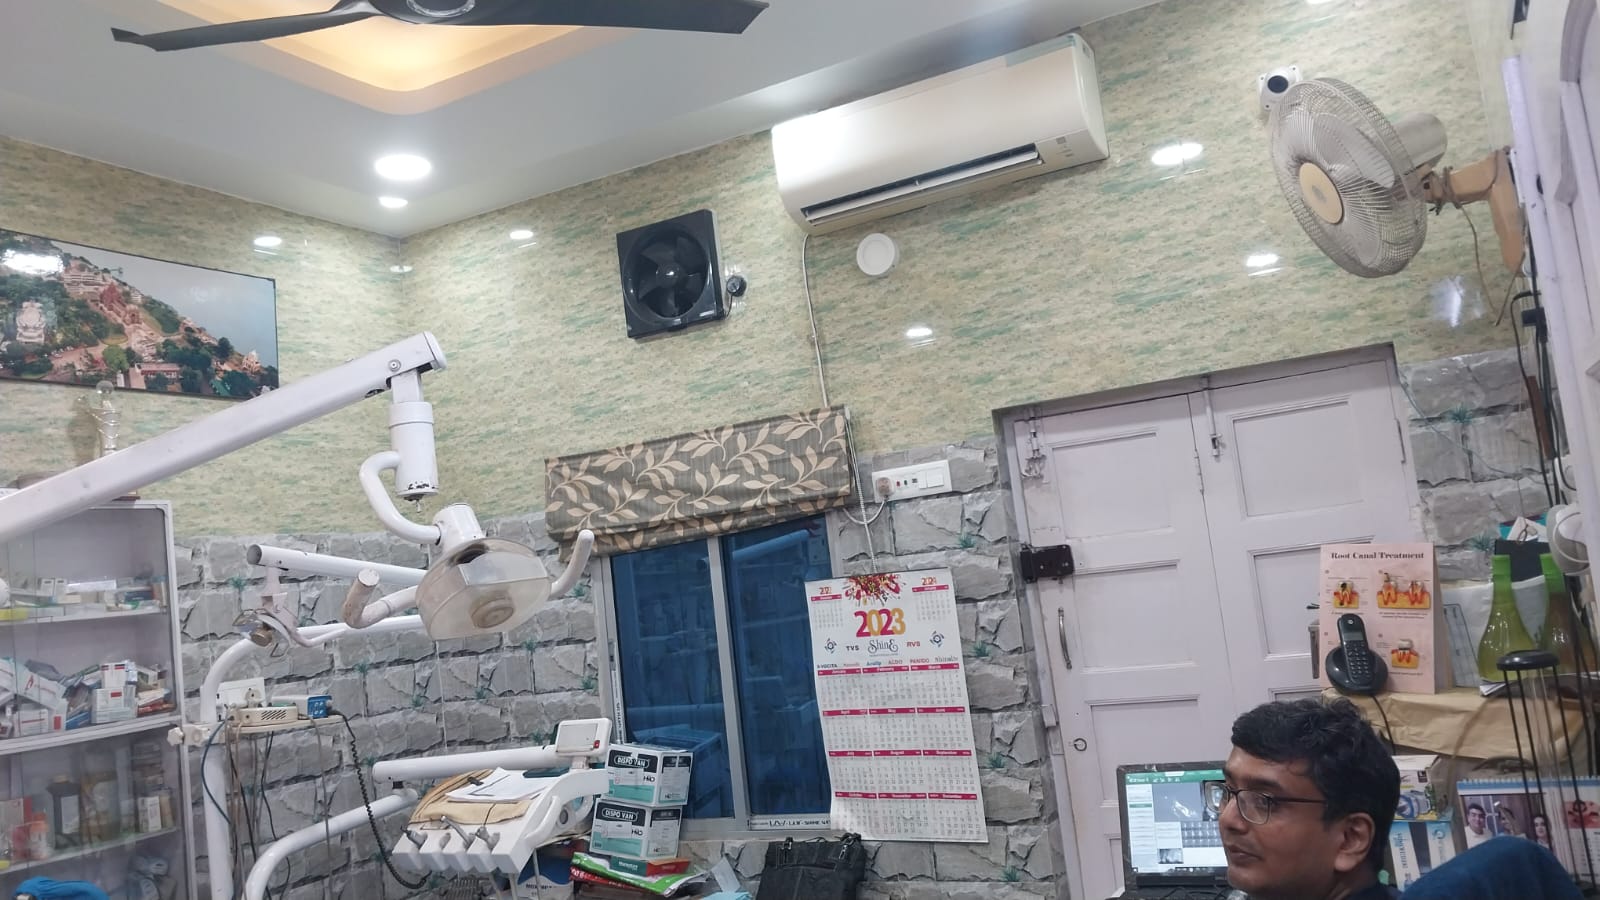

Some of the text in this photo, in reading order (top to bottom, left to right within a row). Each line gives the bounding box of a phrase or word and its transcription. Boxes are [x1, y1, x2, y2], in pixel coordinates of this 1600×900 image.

[1331, 551, 1425, 560] Root Canal Treatment
[854, 608, 906, 637] 2023
[605, 809, 634, 820] DISPO VAN
